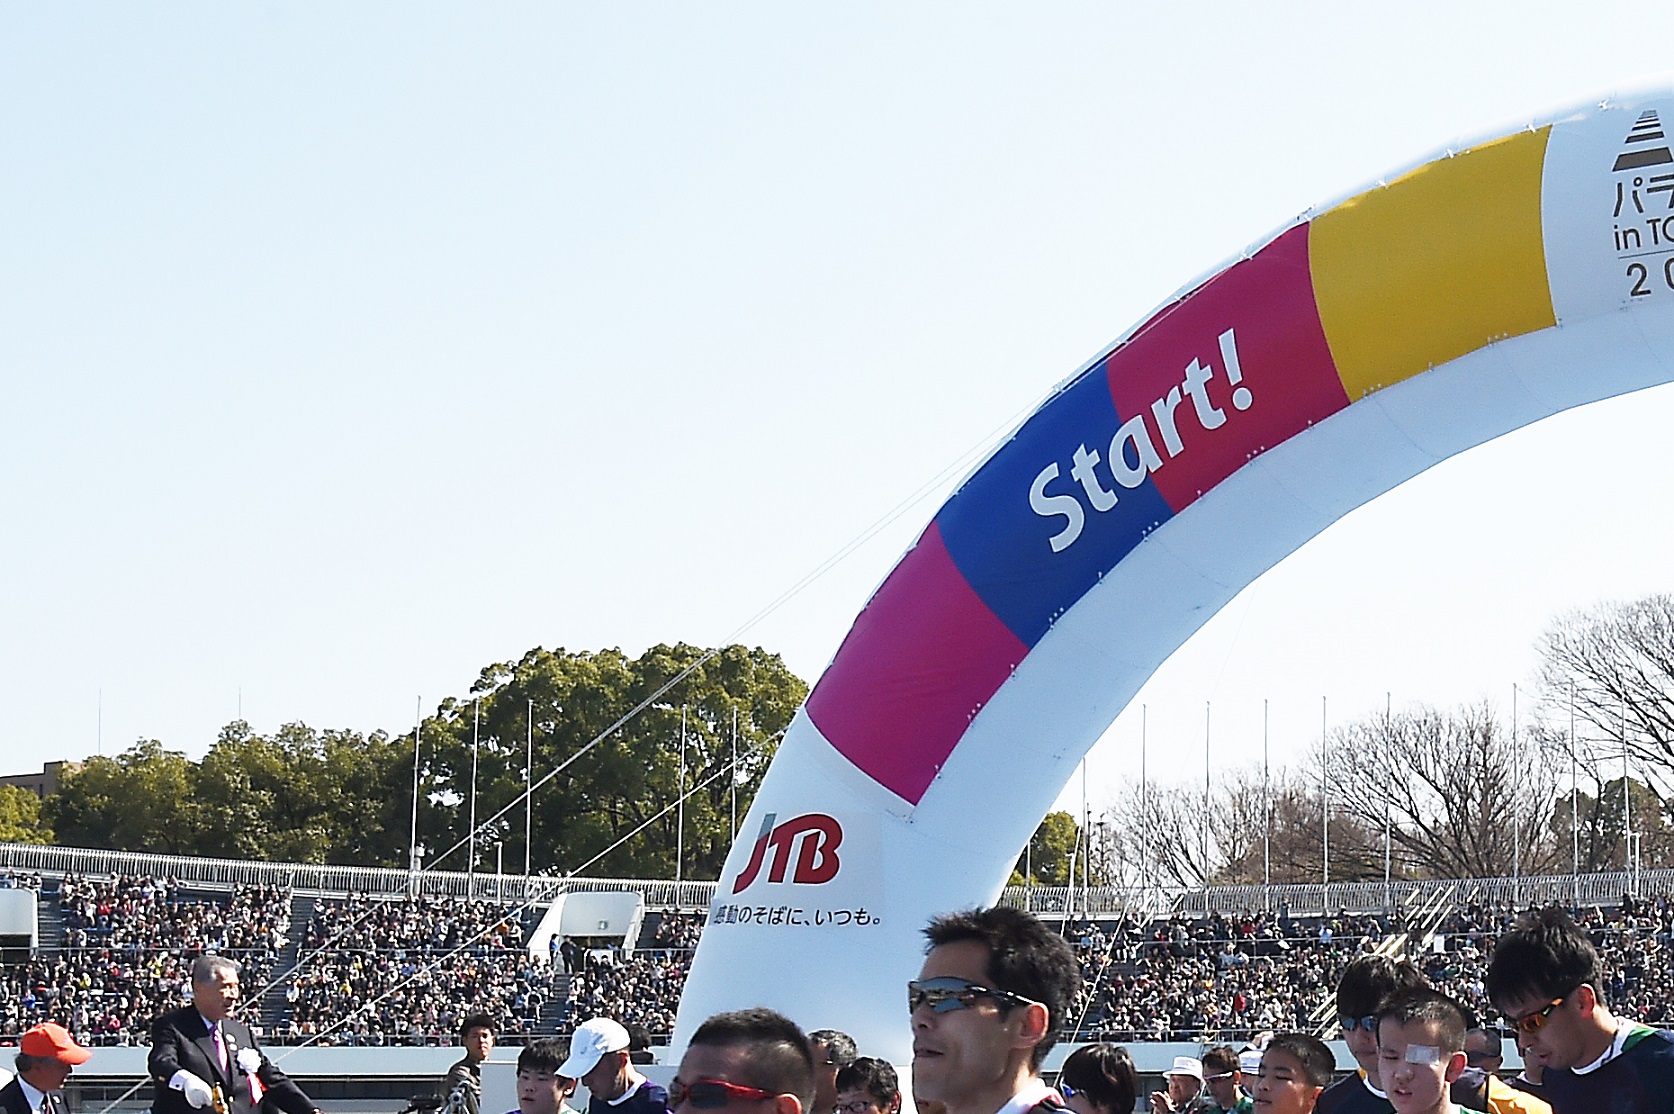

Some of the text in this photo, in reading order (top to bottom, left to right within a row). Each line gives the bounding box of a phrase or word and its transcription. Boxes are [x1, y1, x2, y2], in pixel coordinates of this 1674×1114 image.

[1613, 224, 1641, 250] in
[1029, 328, 1253, 553] Start!
[732, 813, 843, 895] JTB
[714, 904, 881, 926] 感動のそばに、いつも。
